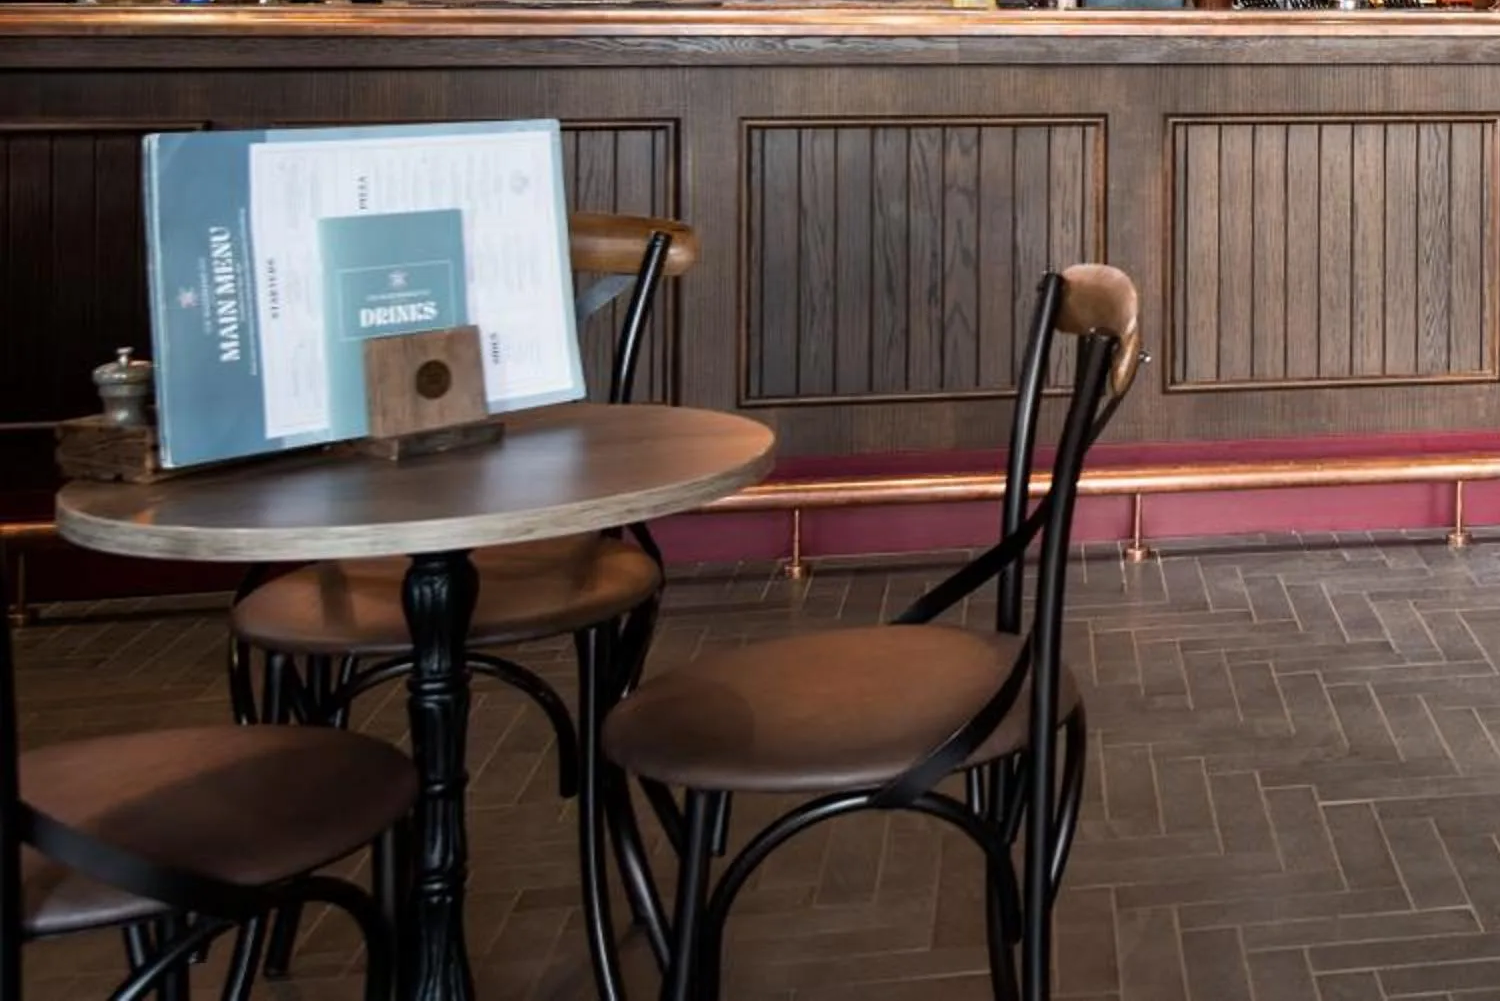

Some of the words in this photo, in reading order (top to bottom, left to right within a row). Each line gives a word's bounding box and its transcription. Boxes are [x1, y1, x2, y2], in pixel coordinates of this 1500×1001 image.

[208, 226, 236, 295] MENU
[216, 300, 241, 362] MAIN
[359, 300, 439, 328] DRINKS
